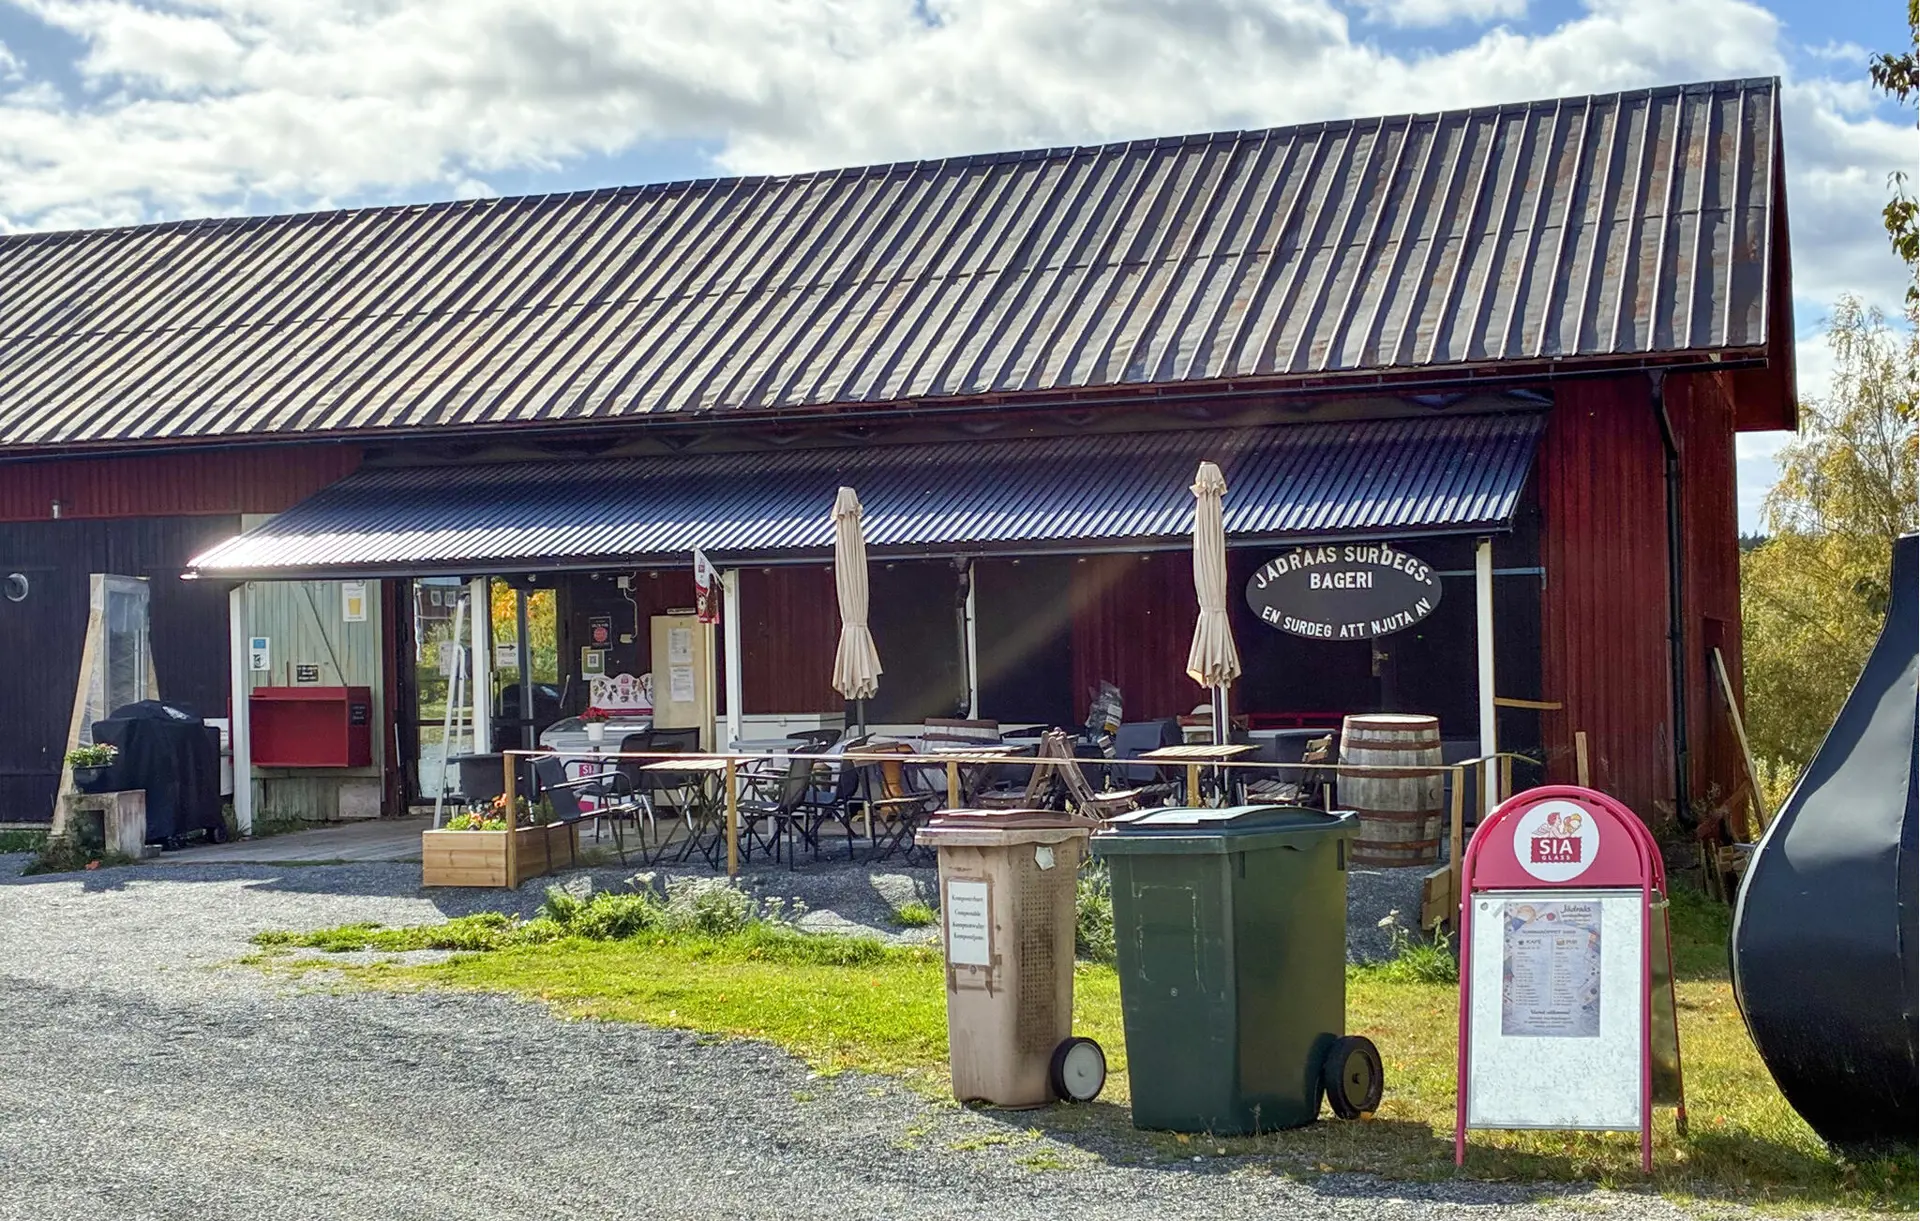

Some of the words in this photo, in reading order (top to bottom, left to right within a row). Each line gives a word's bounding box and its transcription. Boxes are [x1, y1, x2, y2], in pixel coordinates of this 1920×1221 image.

[1310, 571, 1373, 589] BAGERI
[1261, 605, 1281, 624] EN
[1283, 616, 1333, 637] SURDEG
[1339, 622, 1365, 638] ATT
[1370, 610, 1415, 635] NJUTA
[1414, 597, 1431, 617] AV
[1539, 839, 1573, 855] SIA
